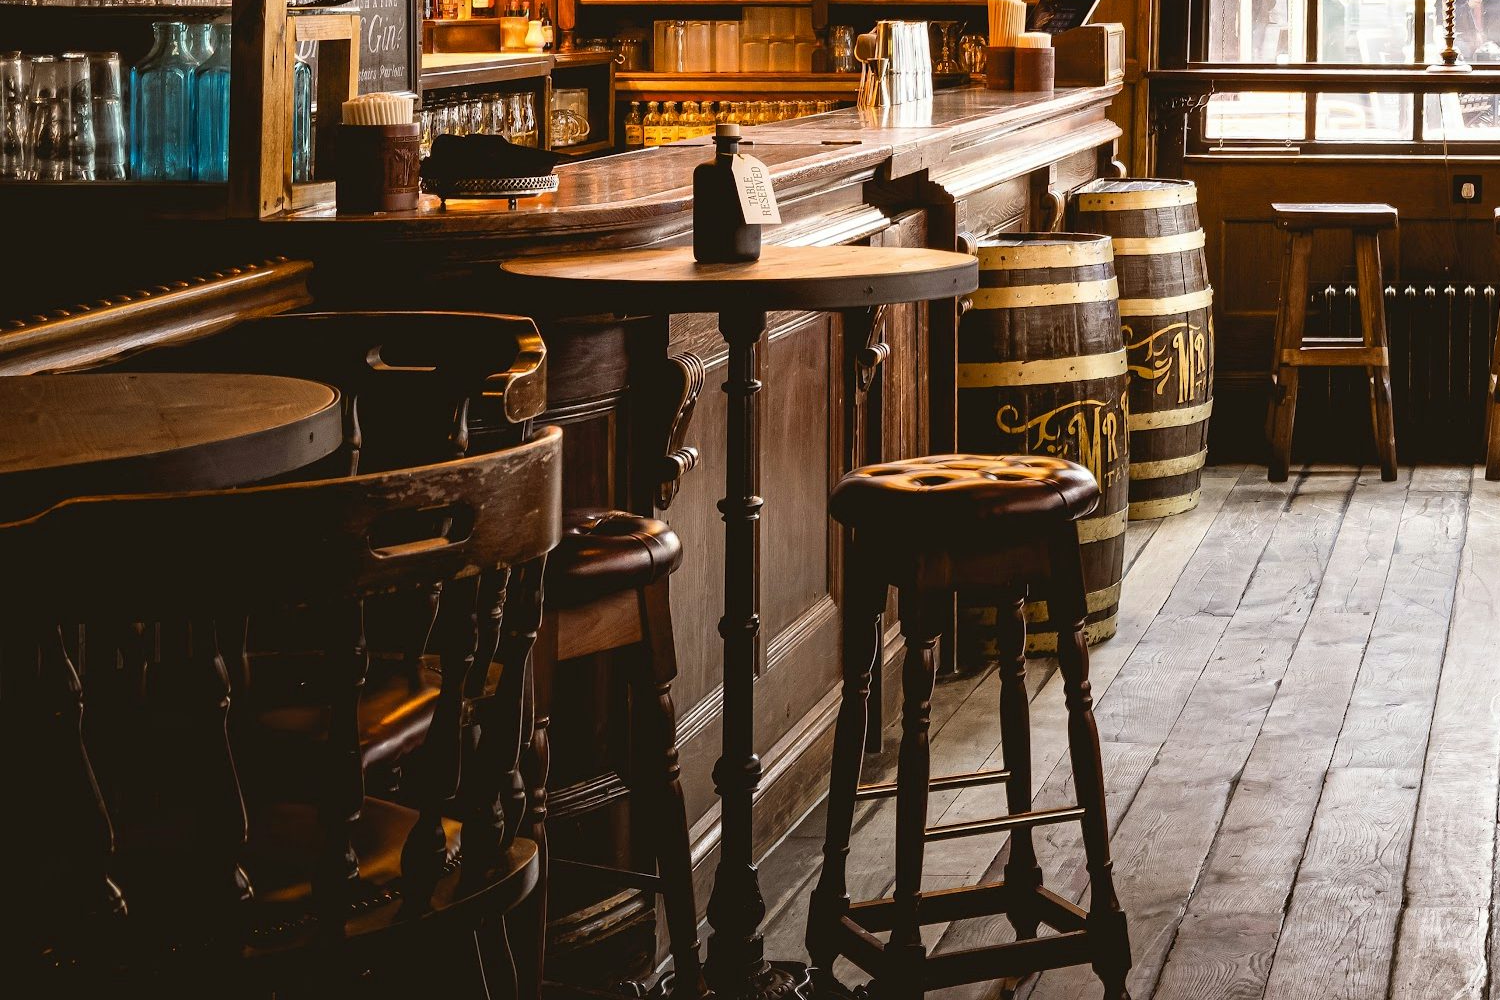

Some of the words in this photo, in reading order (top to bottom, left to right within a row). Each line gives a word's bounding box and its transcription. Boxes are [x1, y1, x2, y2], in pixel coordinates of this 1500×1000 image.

[358, 67, 377, 82] stairs
[743, 176, 759, 206] TABLE
[751, 166, 772, 216] RESERVED
[1067, 406, 1119, 494] MR
